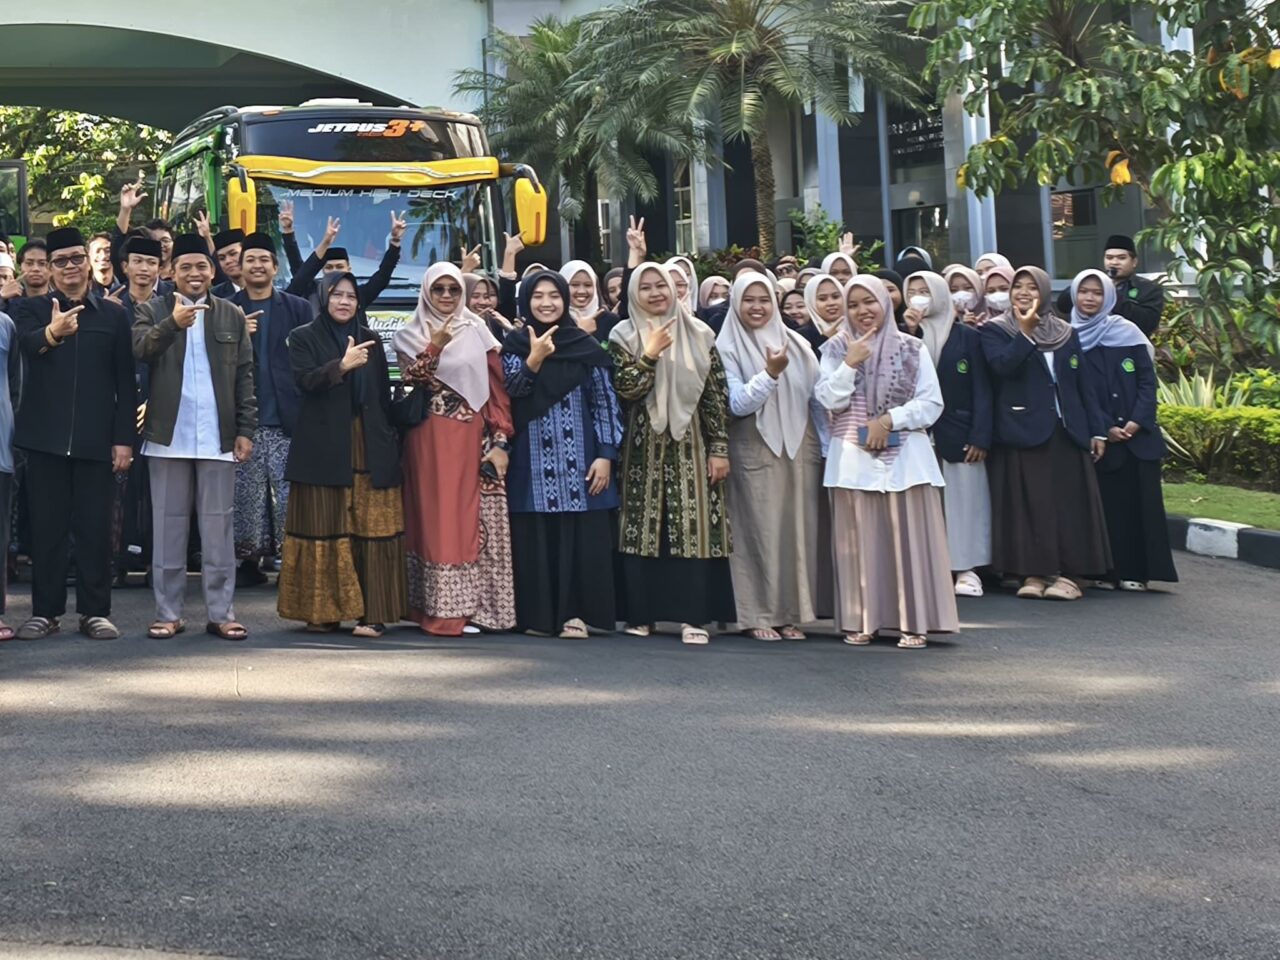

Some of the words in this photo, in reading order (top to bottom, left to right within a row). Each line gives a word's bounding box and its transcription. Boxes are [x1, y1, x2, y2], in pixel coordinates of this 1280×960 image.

[286, 189, 353, 198] MEDIUM
[360, 189, 401, 198] HIH
[407, 190, 459, 199] DECK
